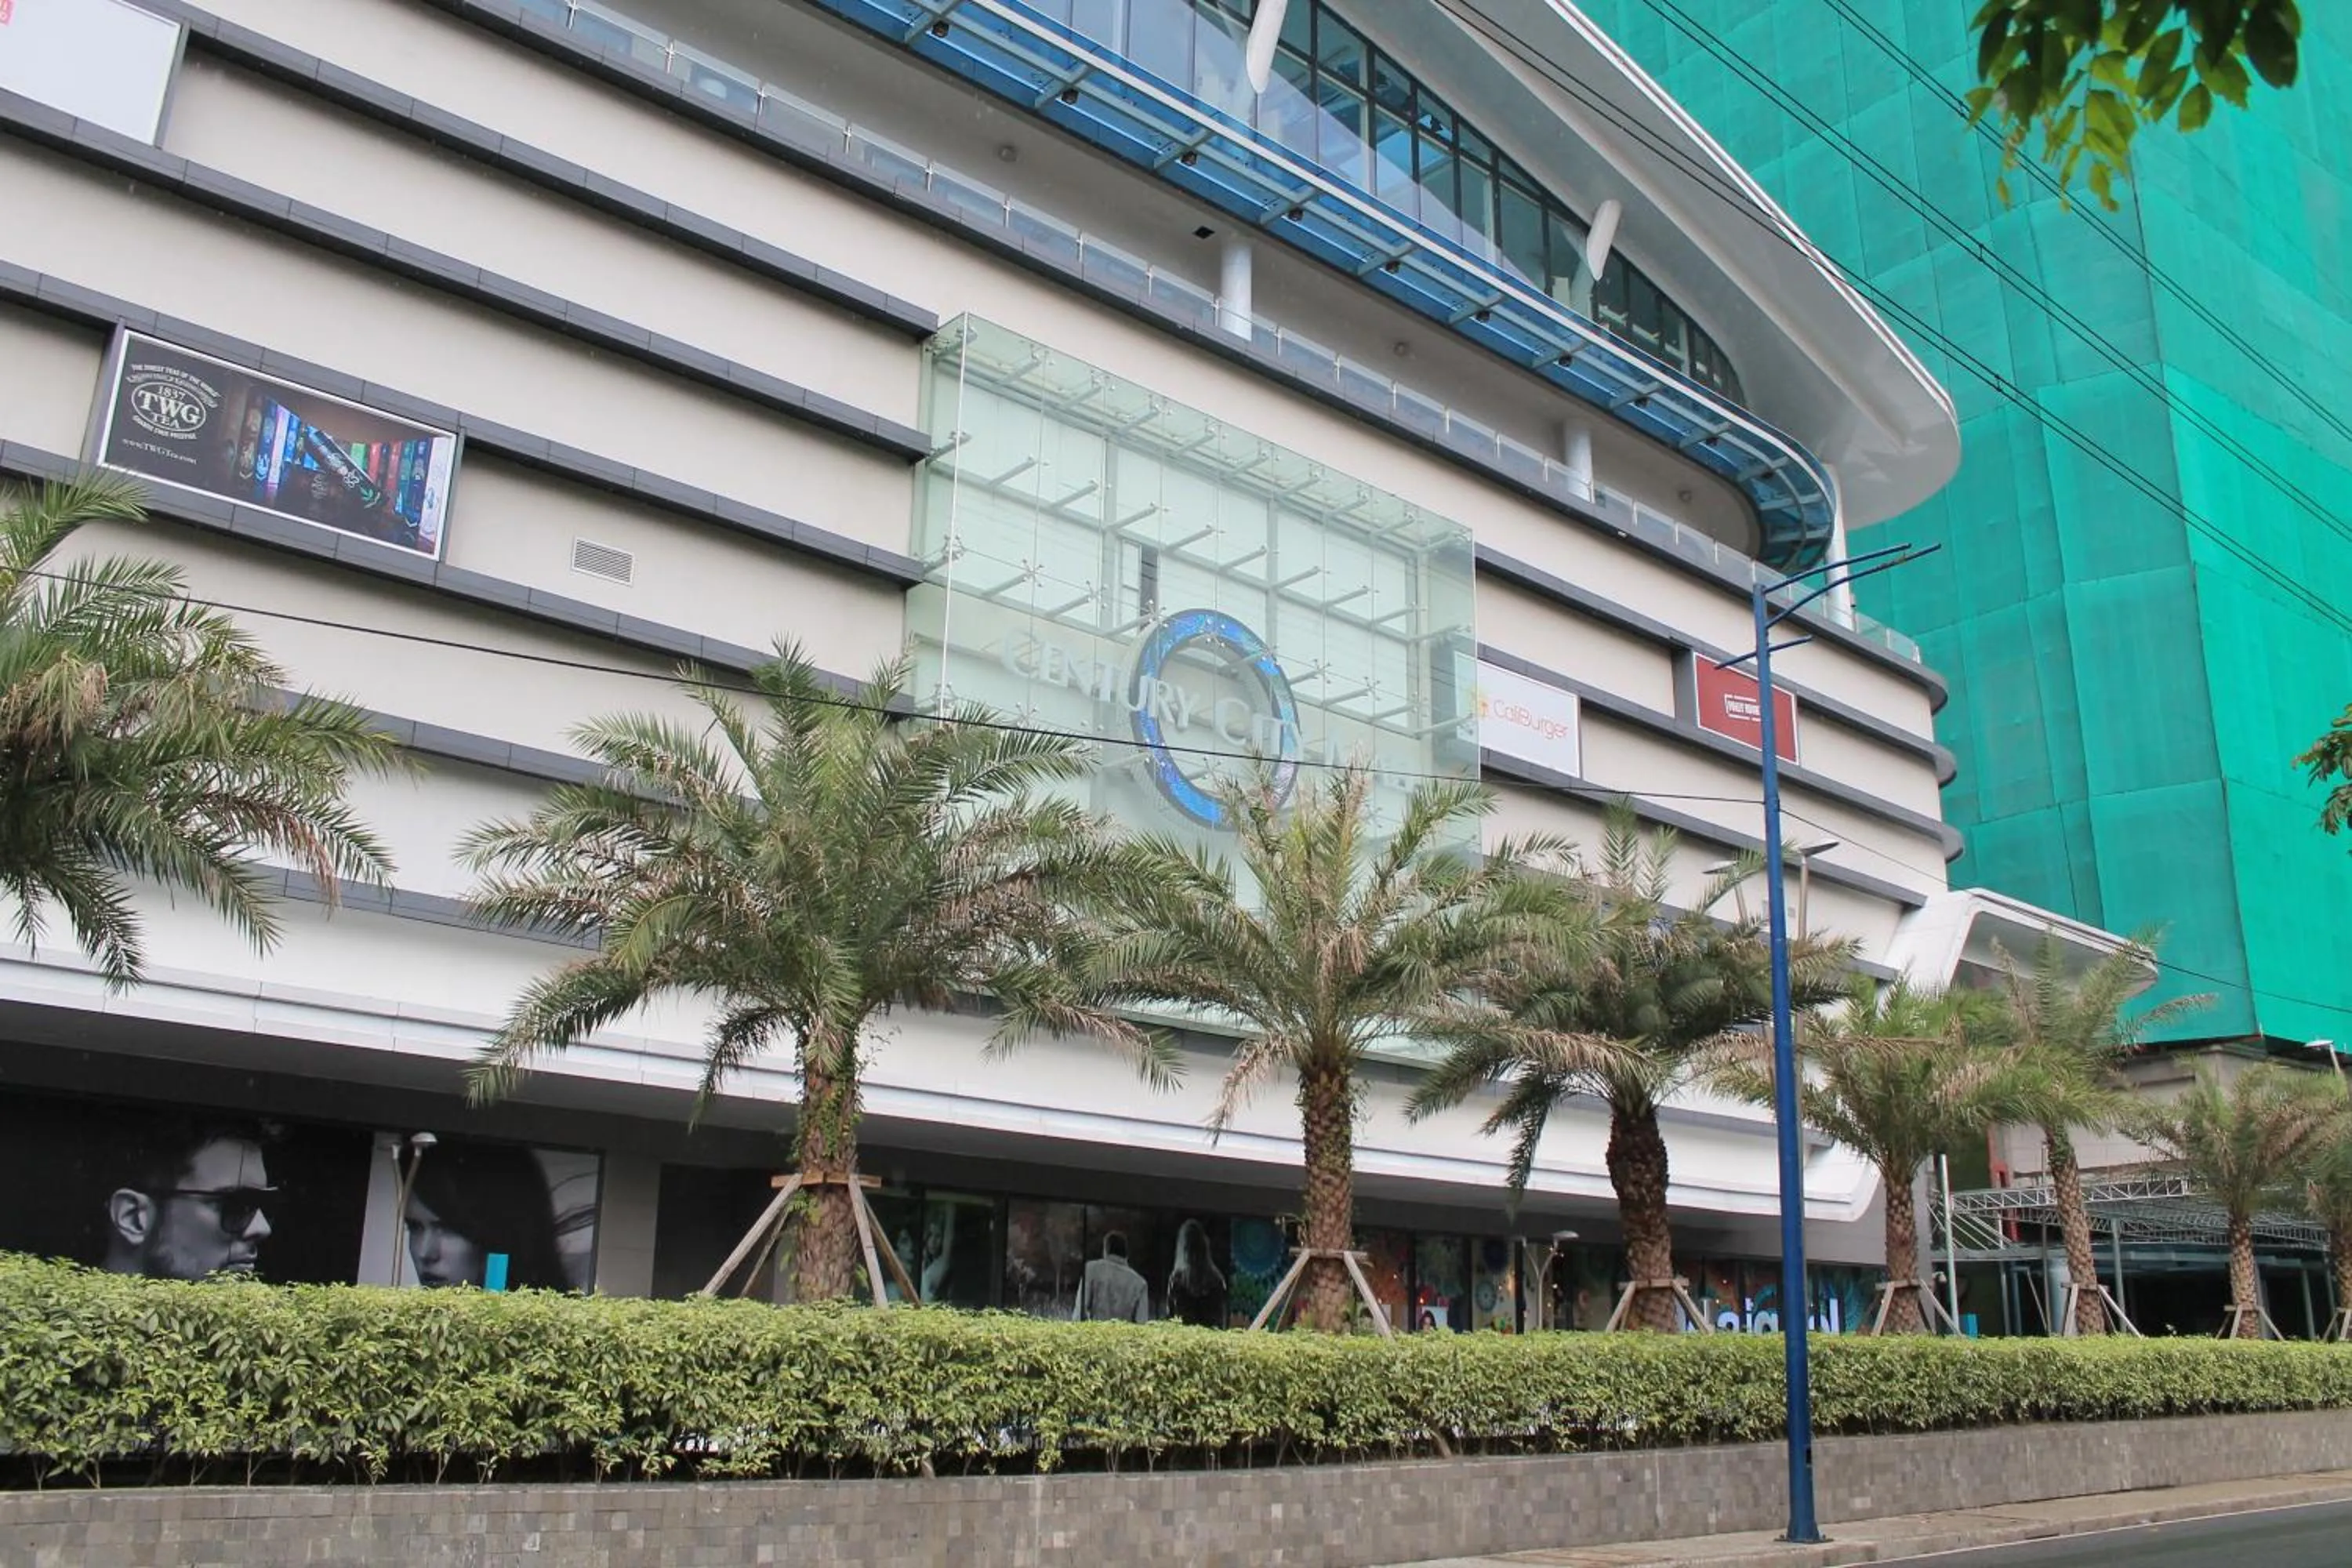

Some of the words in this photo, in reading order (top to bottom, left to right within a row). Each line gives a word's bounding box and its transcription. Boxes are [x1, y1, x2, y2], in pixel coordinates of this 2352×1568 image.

[158, 386, 186, 401] 1837
[138, 390, 201, 424] TWG
[151, 412, 180, 429] TEA
